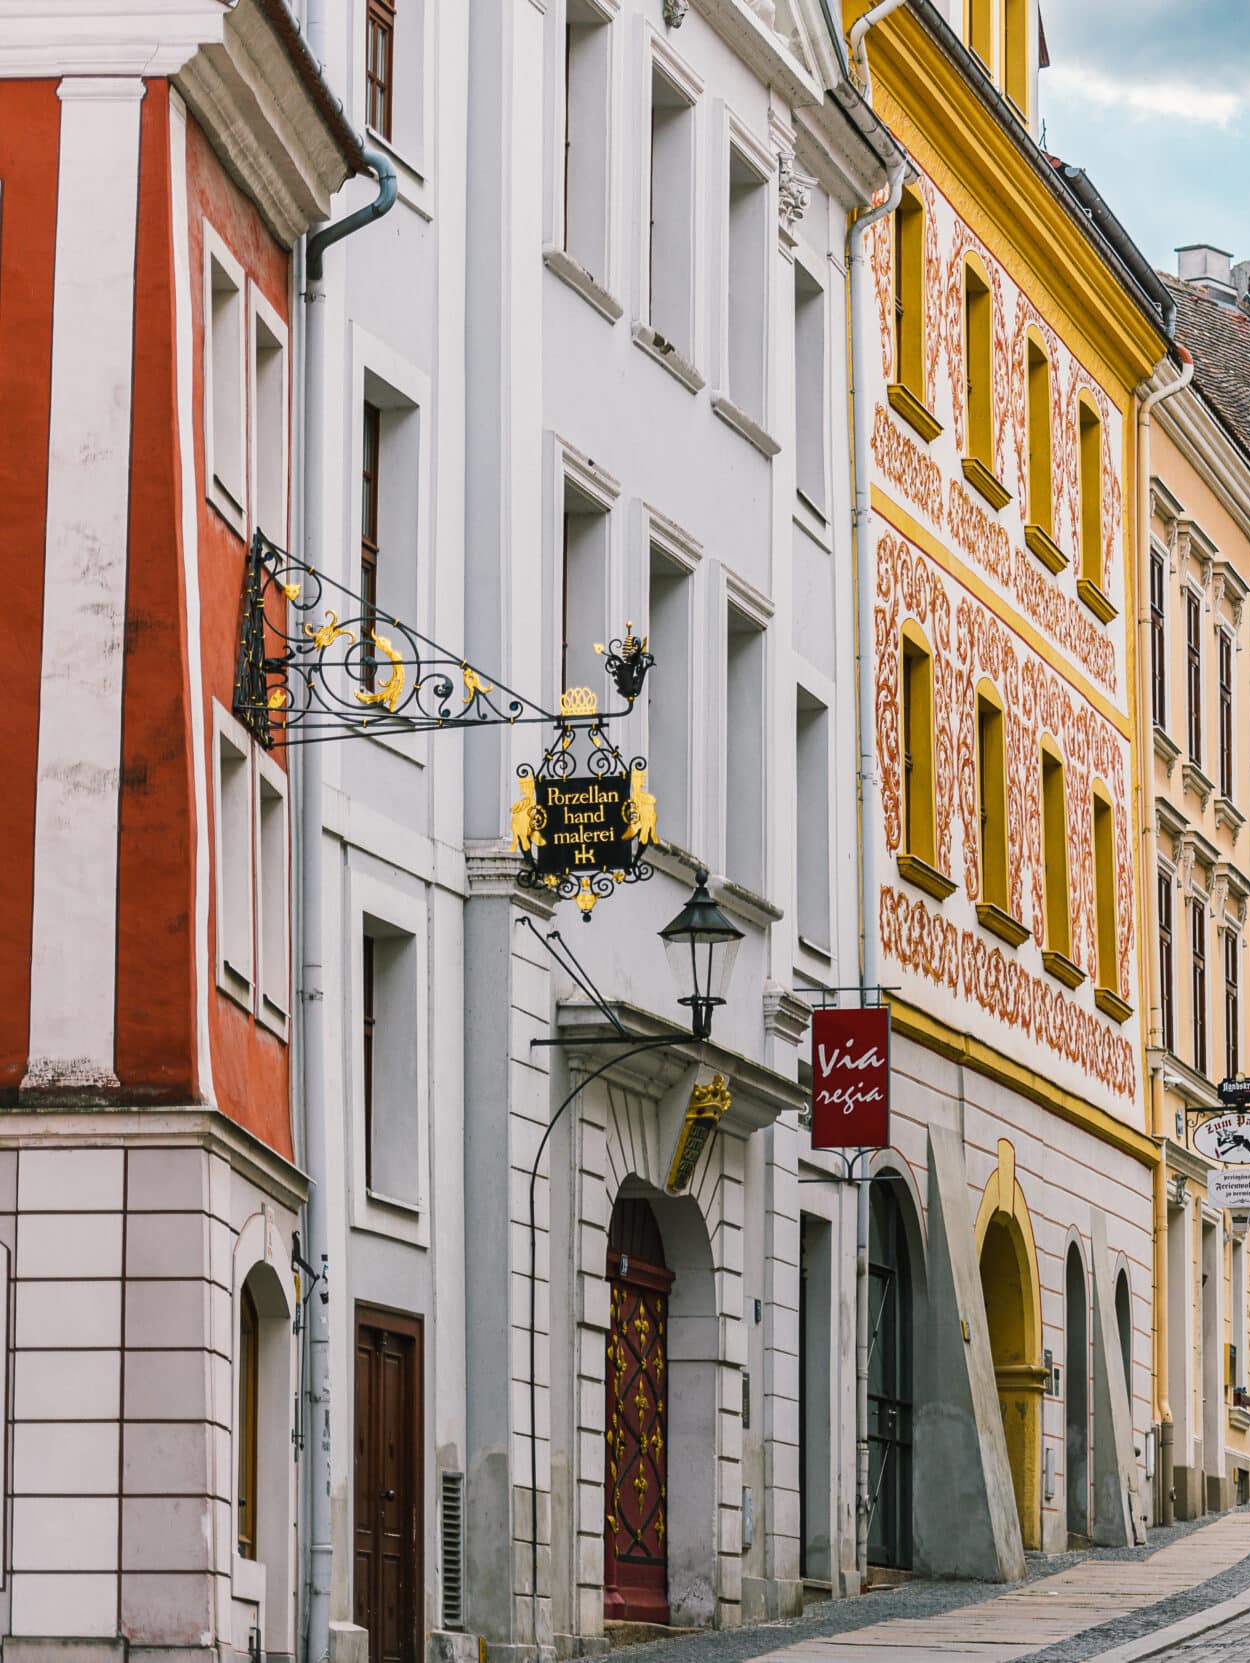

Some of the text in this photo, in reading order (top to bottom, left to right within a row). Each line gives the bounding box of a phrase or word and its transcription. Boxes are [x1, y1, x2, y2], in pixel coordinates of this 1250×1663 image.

[548, 785, 619, 806] Porzellan
[563, 805, 605, 824] hand
[554, 825, 615, 845] malerei
[817, 1038, 885, 1078] Via
[816, 1081, 884, 1115] regia
[1205, 1118, 1232, 1135] Zum
